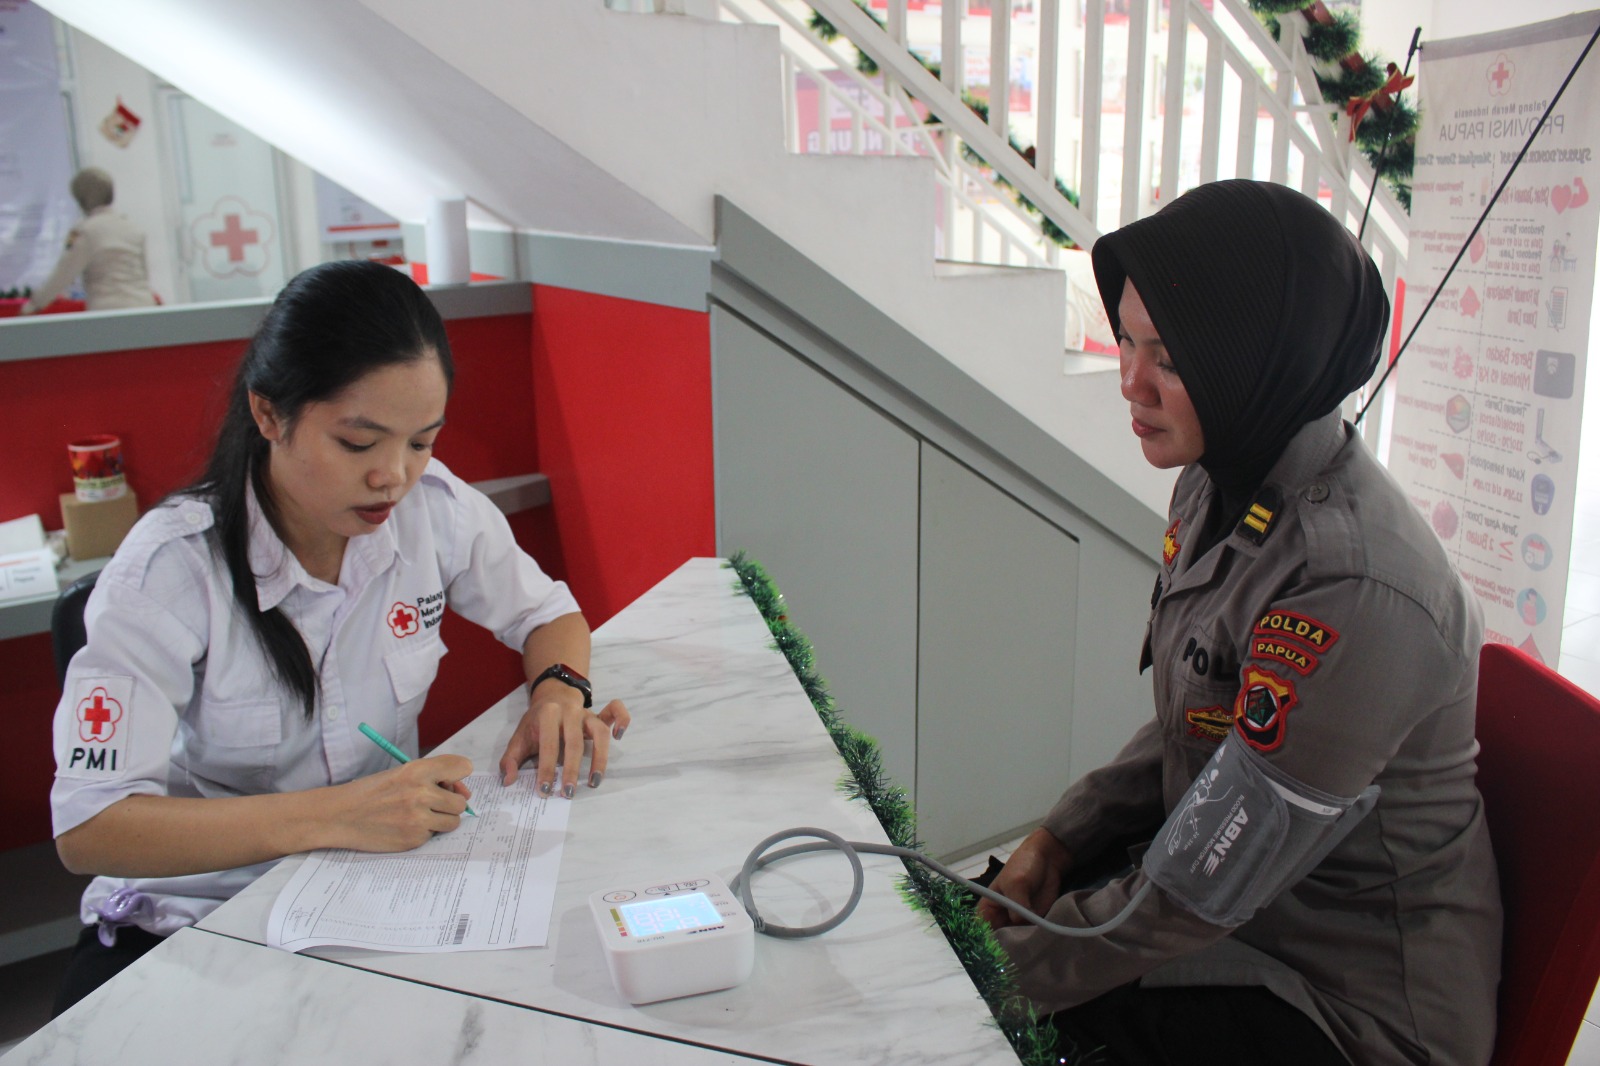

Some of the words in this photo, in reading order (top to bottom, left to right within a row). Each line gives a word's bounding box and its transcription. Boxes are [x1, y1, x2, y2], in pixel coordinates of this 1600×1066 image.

[1260, 615, 1324, 645] POLDA
[1257, 643, 1306, 667] PAPUA
[68, 747, 117, 771] PMI
[1213, 812, 1233, 838] PRESSURE
[1214, 807, 1248, 856] ABN
[1198, 838, 1215, 860] MONITOR
